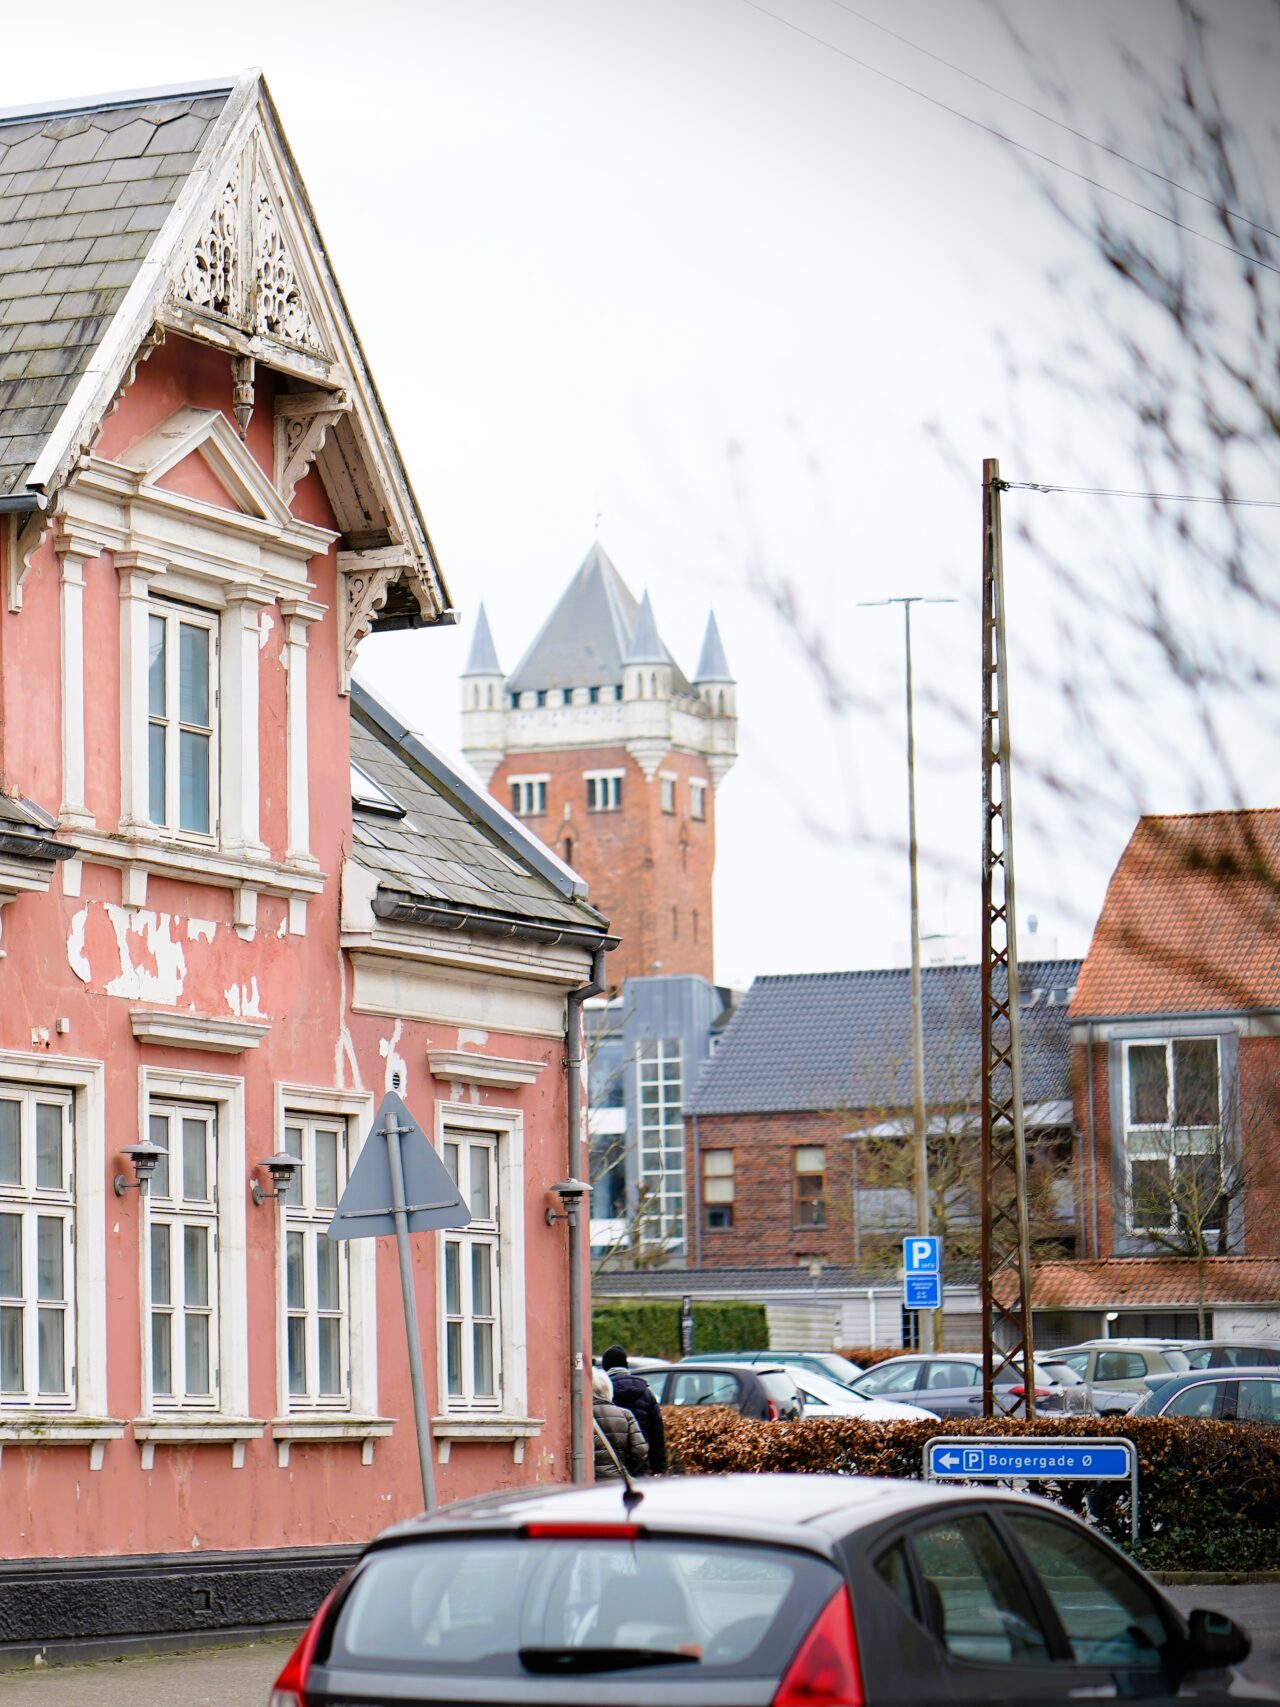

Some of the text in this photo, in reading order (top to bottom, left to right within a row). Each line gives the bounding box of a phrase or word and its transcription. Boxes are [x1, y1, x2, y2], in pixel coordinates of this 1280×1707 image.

[912, 1241, 932, 1269] P
[968, 1453, 1092, 1469] P Borgergade Ø
